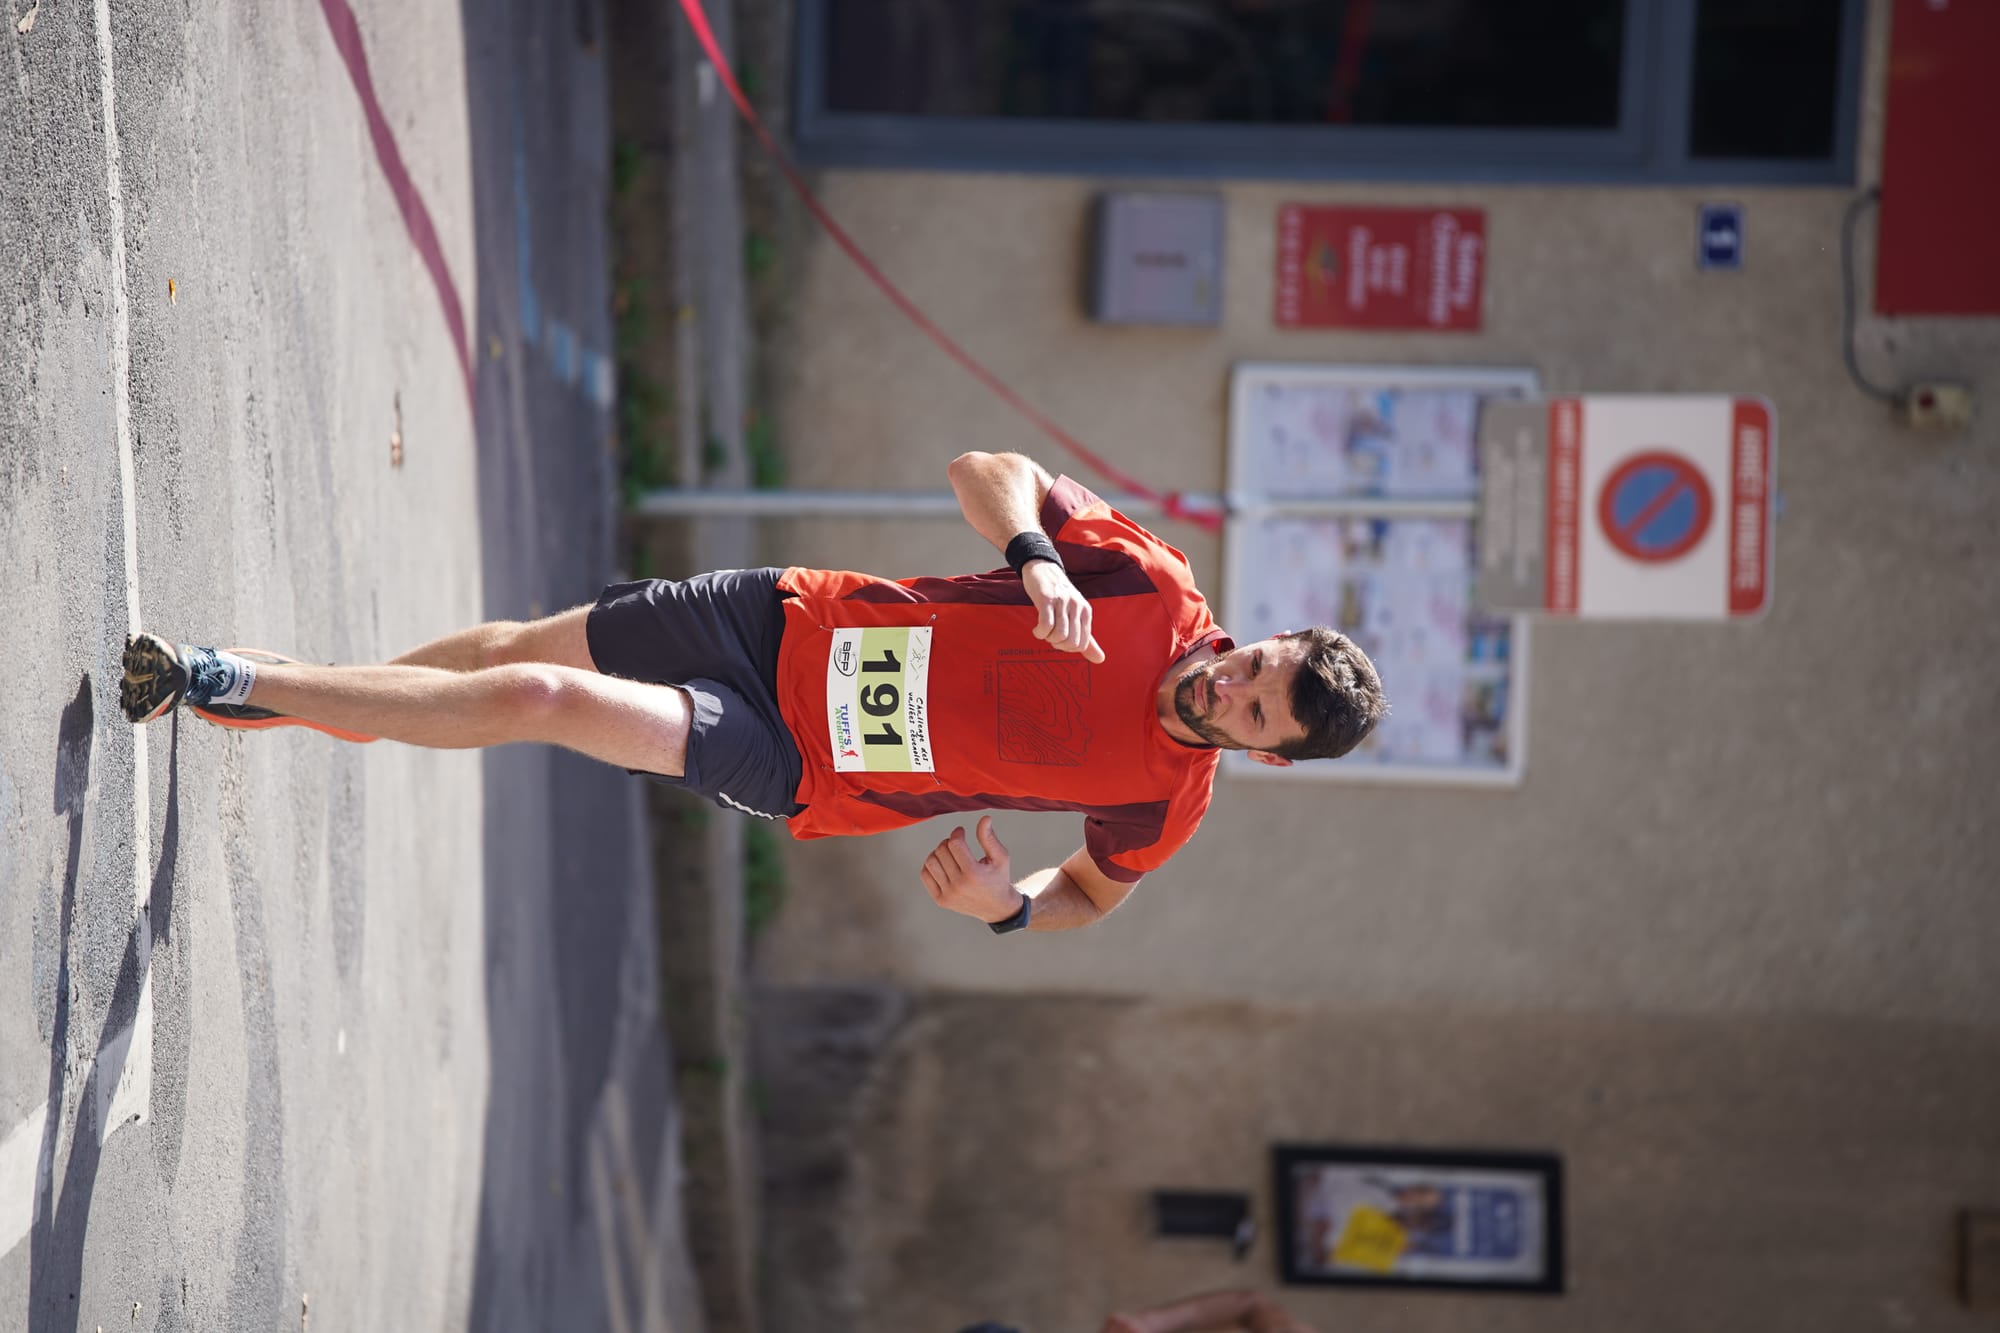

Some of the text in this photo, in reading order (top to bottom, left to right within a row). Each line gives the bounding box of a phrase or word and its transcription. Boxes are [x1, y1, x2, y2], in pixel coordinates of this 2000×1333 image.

[1736, 425, 1767, 589] ARRÊT MINUTE
[842, 641, 852, 671] BFP
[835, 707, 846, 750] Aventure
[840, 704, 852, 746] TUFF'S
[861, 649, 903, 745] 191
[908, 692, 921, 766] vallées cévenoles
[916, 697, 929, 762] Challenge des
